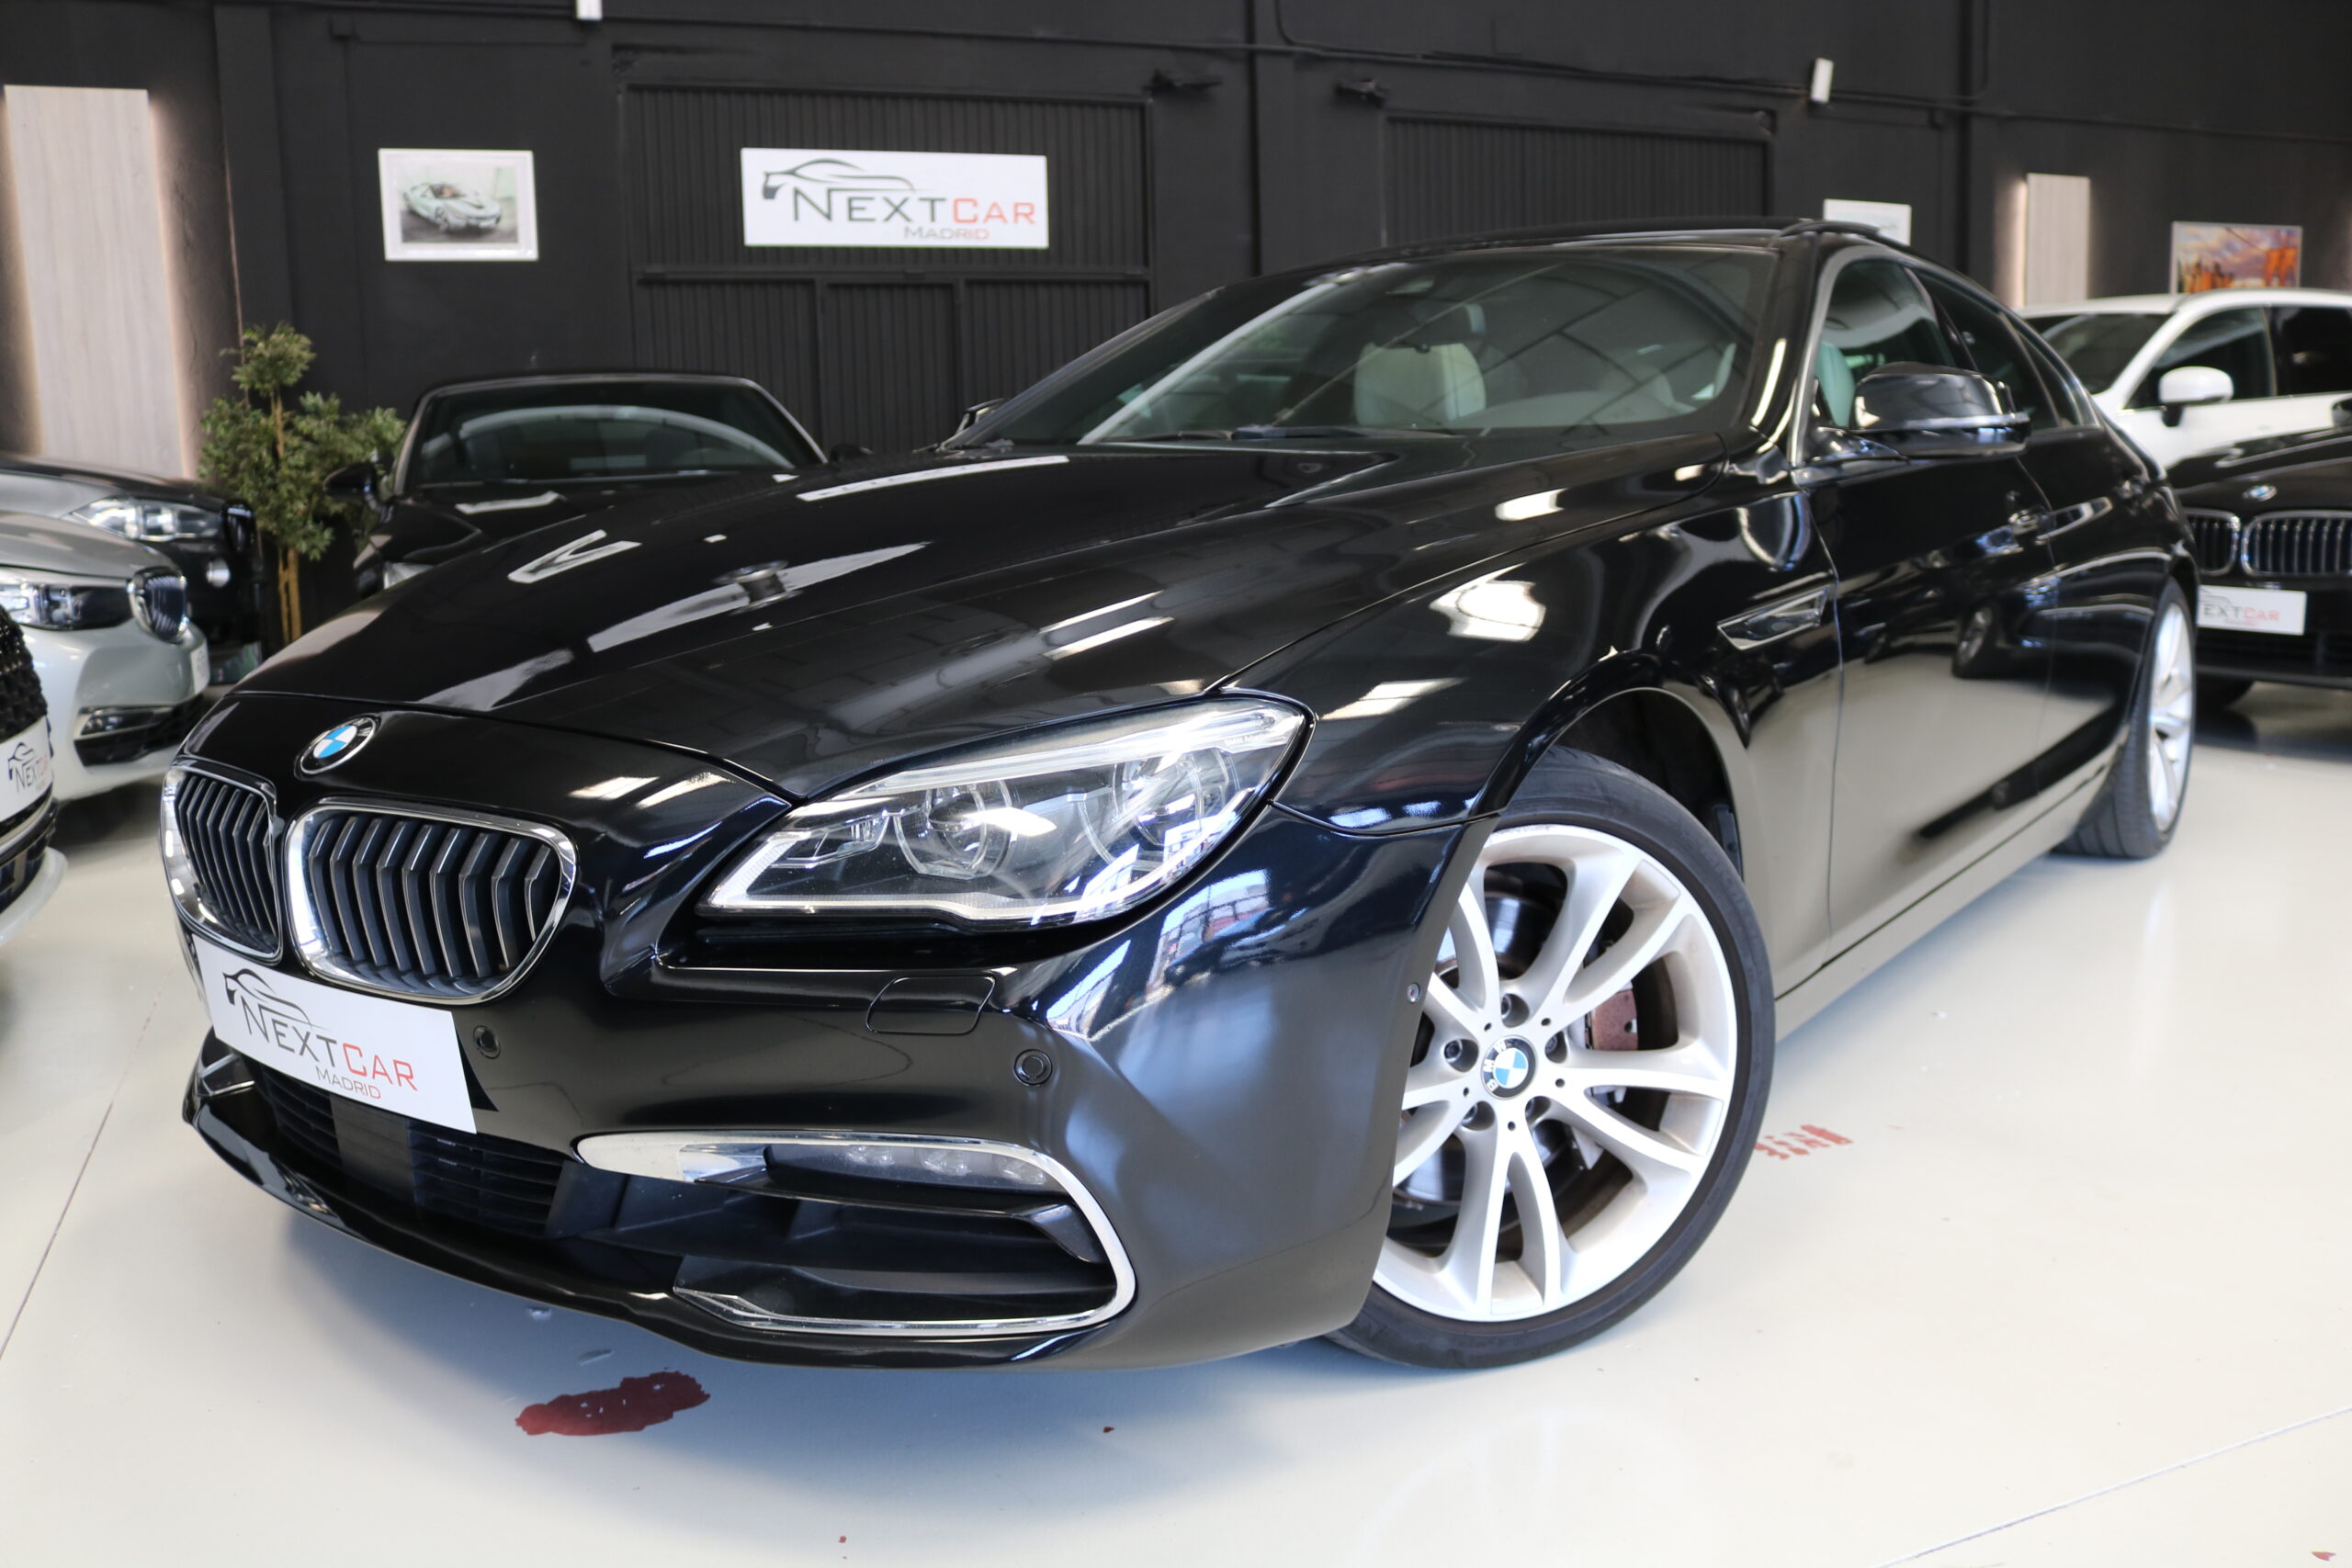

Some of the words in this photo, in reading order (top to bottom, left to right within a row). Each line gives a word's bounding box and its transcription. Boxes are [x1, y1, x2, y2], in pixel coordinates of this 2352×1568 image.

[793, 186, 1036, 224] NEXTCAR
[904, 226, 989, 241] MADRID
[2203, 603, 2279, 622] EXTCAR
[241, 995, 419, 1091] NEXTCAR
[1483, 1037, 1508, 1092] BMW
[315, 1066, 382, 1100] MADRID
